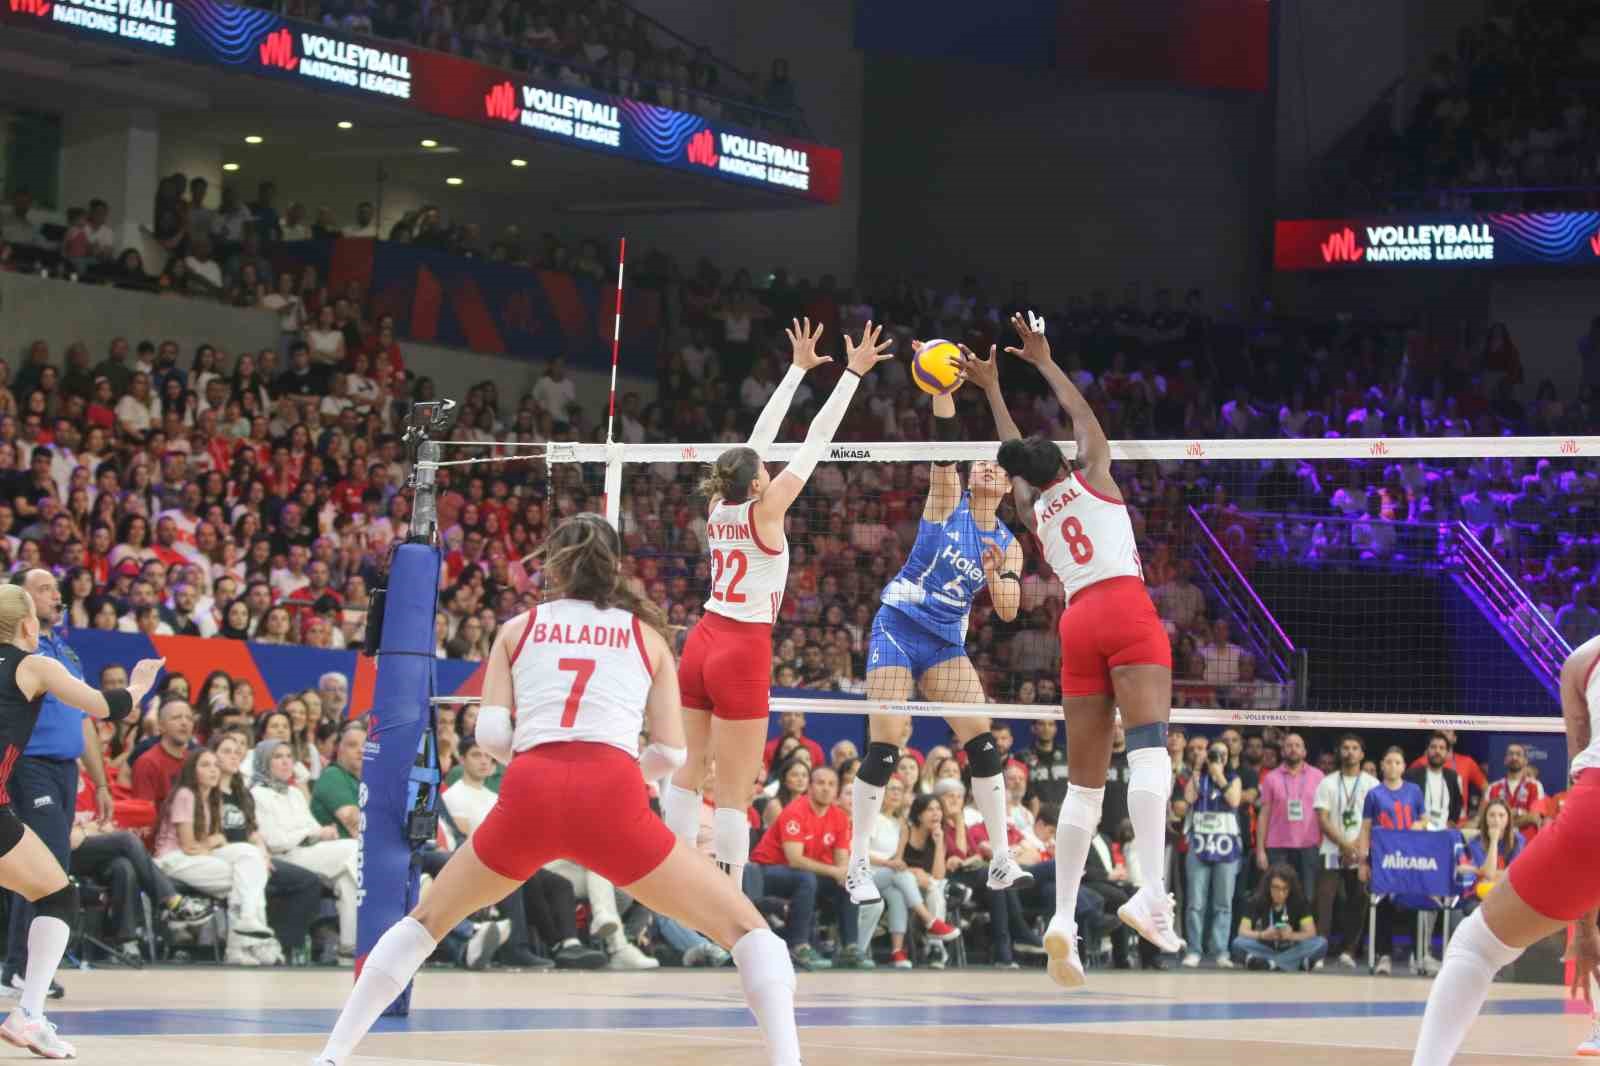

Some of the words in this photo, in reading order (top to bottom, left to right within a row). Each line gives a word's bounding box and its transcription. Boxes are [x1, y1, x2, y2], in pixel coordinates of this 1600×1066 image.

[52, 4, 118, 33] NATIONS
[119, 18, 177, 46] LEAGUE
[301, 33, 411, 79] VOLLEYBALL
[299, 58, 359, 86] NATIONS
[359, 71, 411, 98] LEAGUE
[522, 85, 621, 129] VOLLEYBALL
[520, 109, 573, 136] NATIONS
[573, 121, 620, 147] LEAGUE
[718, 154, 767, 181] NATIONS
[767, 165, 809, 190] LEAGUE
[720, 131, 810, 173] VOLLEYBALL
[1366, 224, 1494, 246] VOLLEYBALL
[1366, 247, 1432, 262] NATIONS
[1435, 246, 1494, 261] LEAGUE
[707, 523, 750, 540] AYDIN
[1060, 516, 1094, 566] 8
[533, 622, 631, 649] BALADIN
[558, 657, 596, 728] 7
